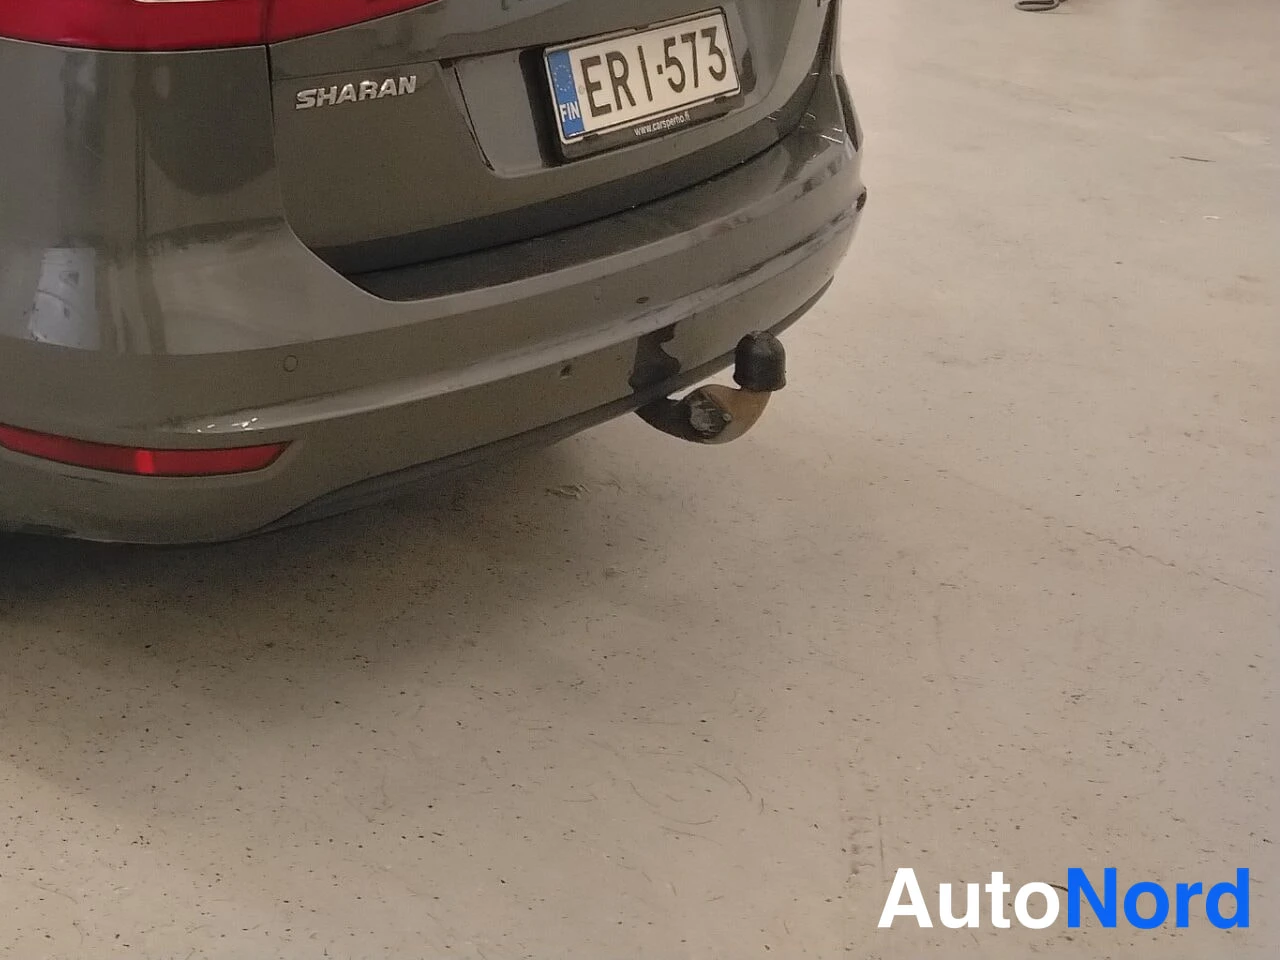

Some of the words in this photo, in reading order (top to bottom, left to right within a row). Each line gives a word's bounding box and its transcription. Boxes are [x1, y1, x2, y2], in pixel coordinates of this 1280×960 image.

[579, 25, 727, 118] ERI-573
[295, 75, 417, 110] SHARAN
[559, 100, 581, 123] FIN
[633, 110, 691, 137] www.carsperho.fi
